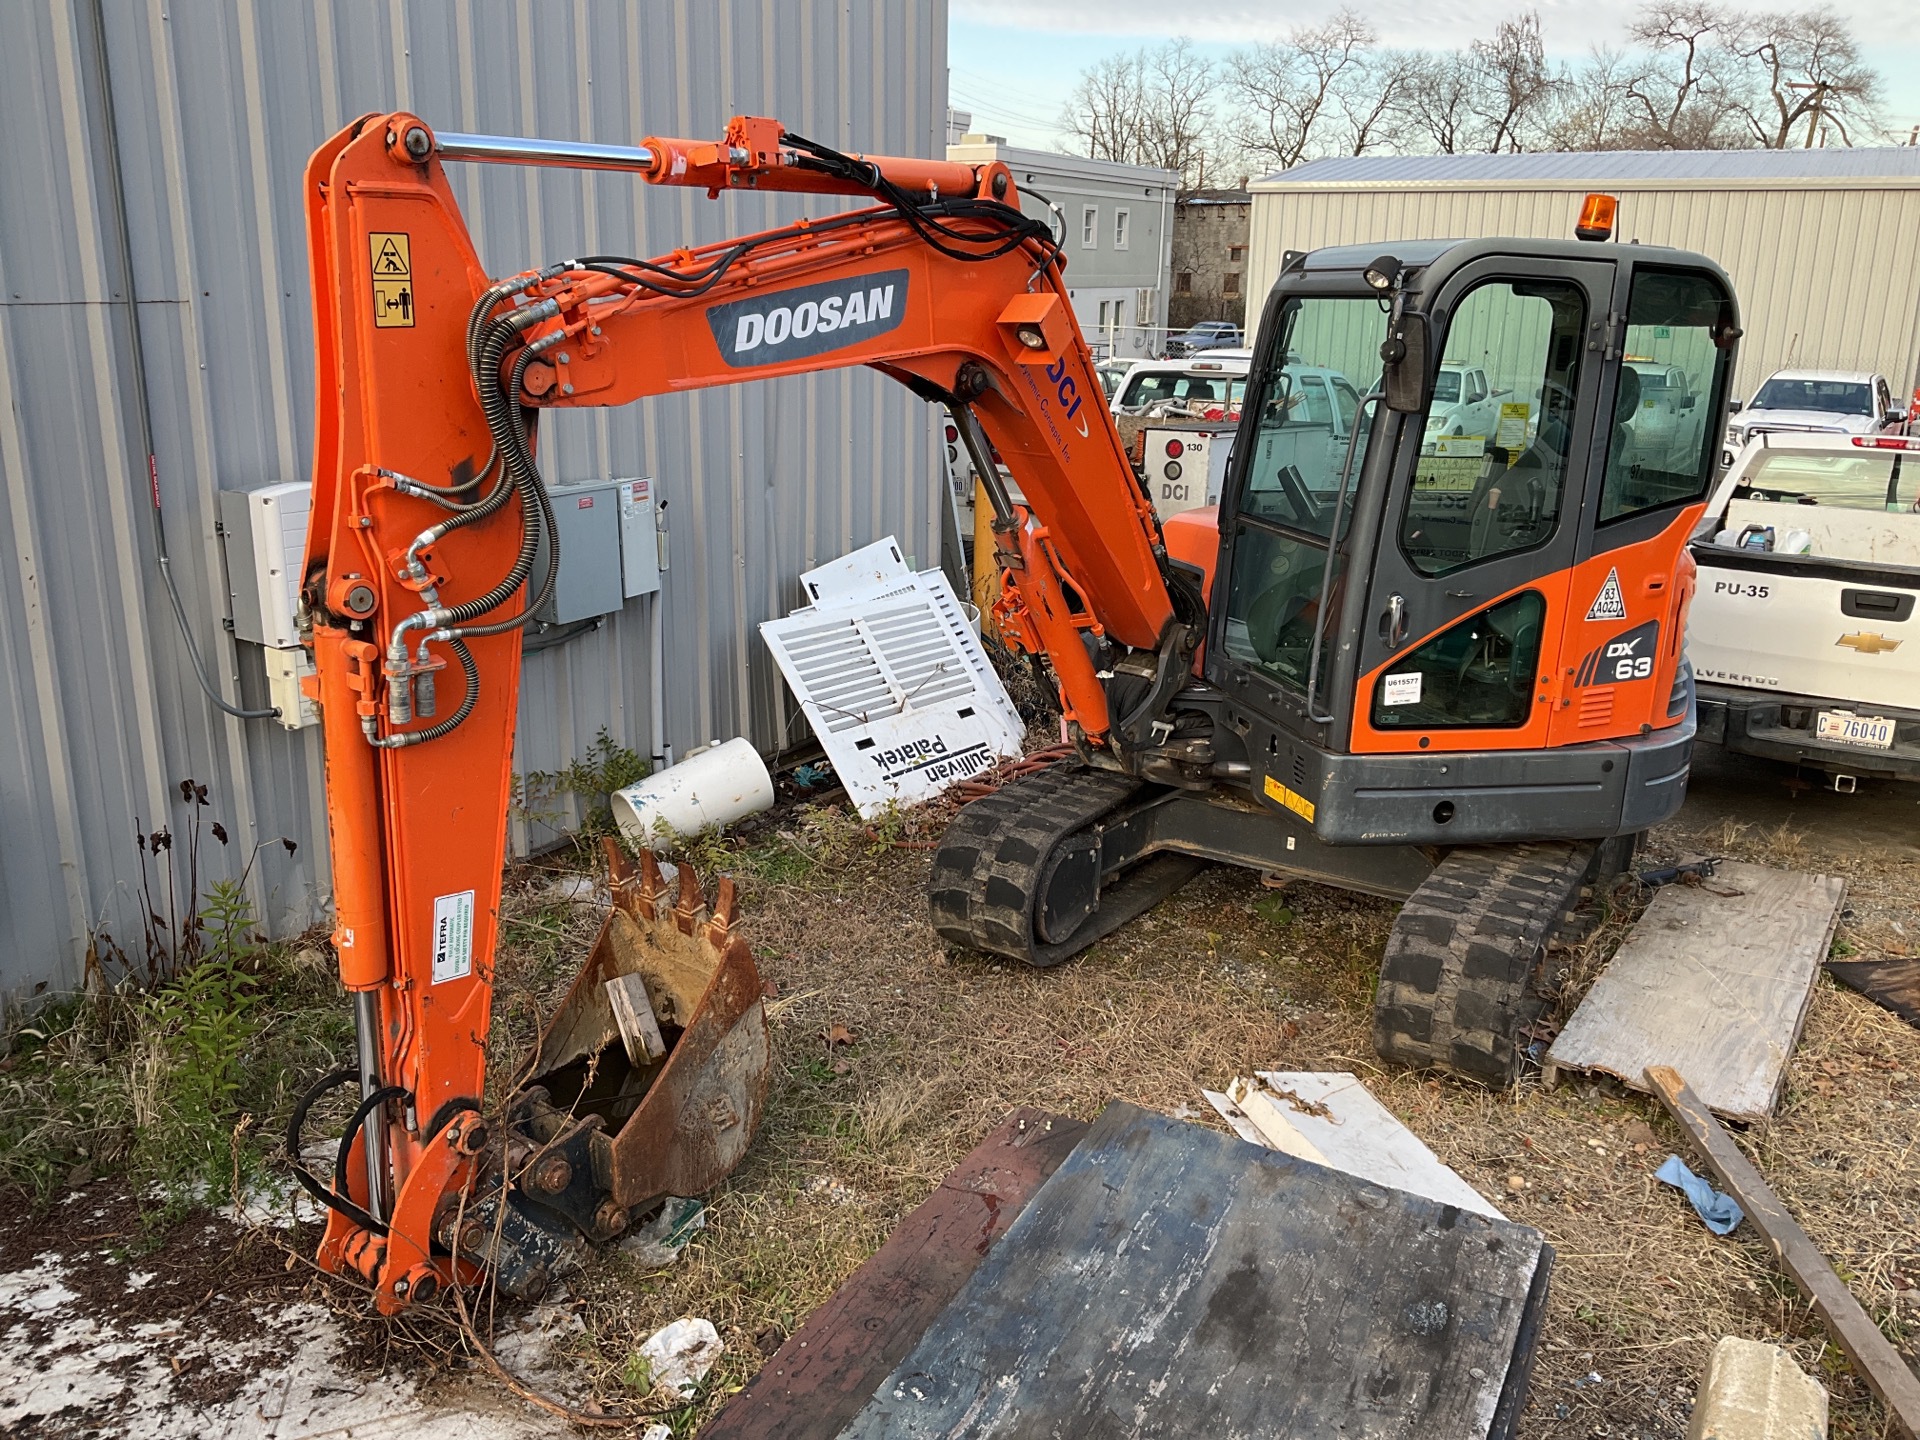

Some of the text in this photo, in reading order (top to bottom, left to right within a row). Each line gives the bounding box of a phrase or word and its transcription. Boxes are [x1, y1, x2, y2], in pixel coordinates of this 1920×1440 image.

[735, 285, 894, 353] DOOSAN
[1046, 356, 1082, 420] DCI
[1061, 443, 1071, 463] Inc
[1186, 443, 1203, 452] 130
[953, 481, 962, 491] 00
[1161, 484, 1190, 501] DCI
[1604, 588, 1615, 599] 83
[1714, 582, 1769, 598] PU-35
[1606, 637, 1642, 657] DX
[1615, 657, 1651, 680] 63
[1388, 678, 1418, 687] U615577
[1818, 717, 1887, 741] C 76040
[870, 734, 948, 771] Palatek
[924, 748, 997, 783] Sullivan
[439, 916, 448, 952] TEFRA
